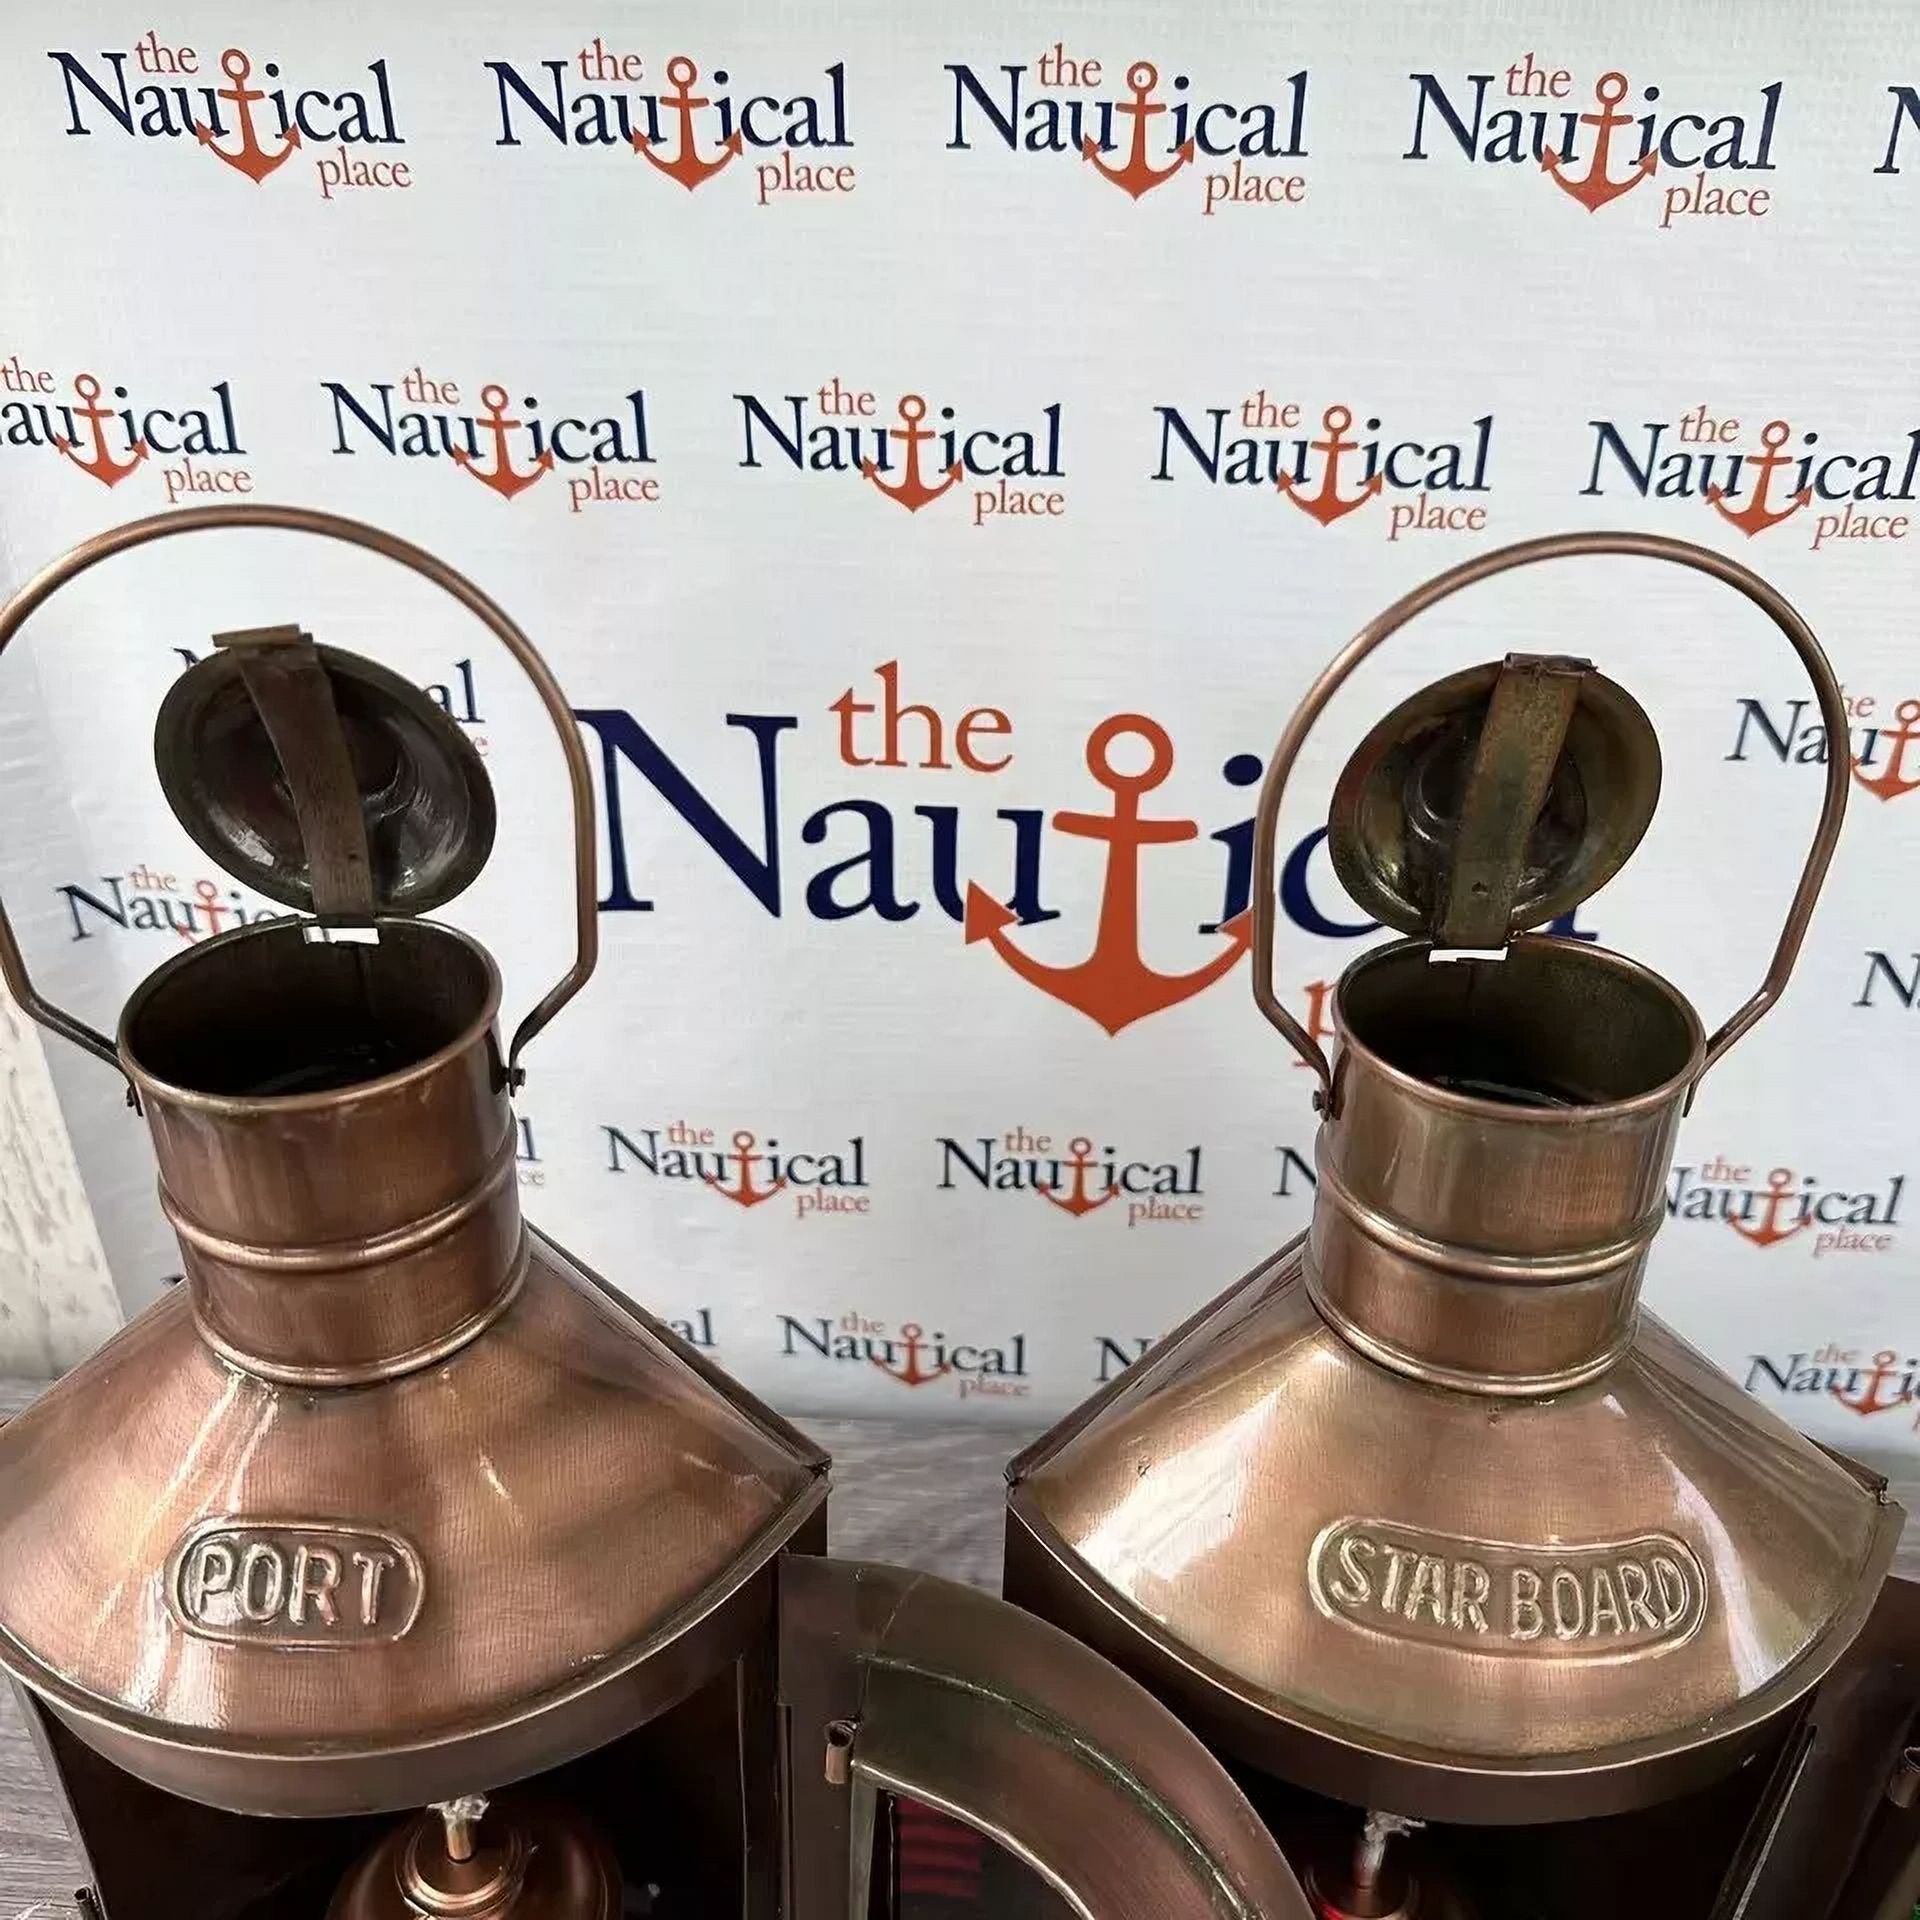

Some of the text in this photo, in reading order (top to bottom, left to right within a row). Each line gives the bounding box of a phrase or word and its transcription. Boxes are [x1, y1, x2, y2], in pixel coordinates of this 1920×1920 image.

[135, 31, 198, 75] the
[578, 38, 643, 82] the
[1037, 43, 1103, 88] the
[1507, 54, 1571, 100] the
[320, 145, 412, 199] place
[756, 150, 857, 205] place
[1203, 160, 1306, 215] place
[1660, 173, 1770, 229] place
[0, 355, 55, 394] the
[403, 367, 460, 409] the
[817, 379, 876, 419] the
[1241, 390, 1300, 432] the
[0, 373, 248, 489] autical
[1679, 404, 1740, 443] the
[163, 457, 254, 504] place
[568, 454, 660, 514] place
[973, 478, 1065, 526] place
[1387, 495, 1487, 541] place
[1808, 502, 1910, 552] place
[828, 659, 1014, 774] the
[128, 863, 177, 892] the
[667, 1120, 714, 1148] the
[1004, 1126, 1051, 1155] the
[1701, 1155, 1751, 1182] the
[796, 1186, 871, 1220] place
[1127, 1194, 1203, 1229] place
[1813, 1225, 1894, 1259] place
[840, 1310, 886, 1336] the
[958, 1374, 1032, 1401] place
[190, 1541, 397, 1626] PORT
